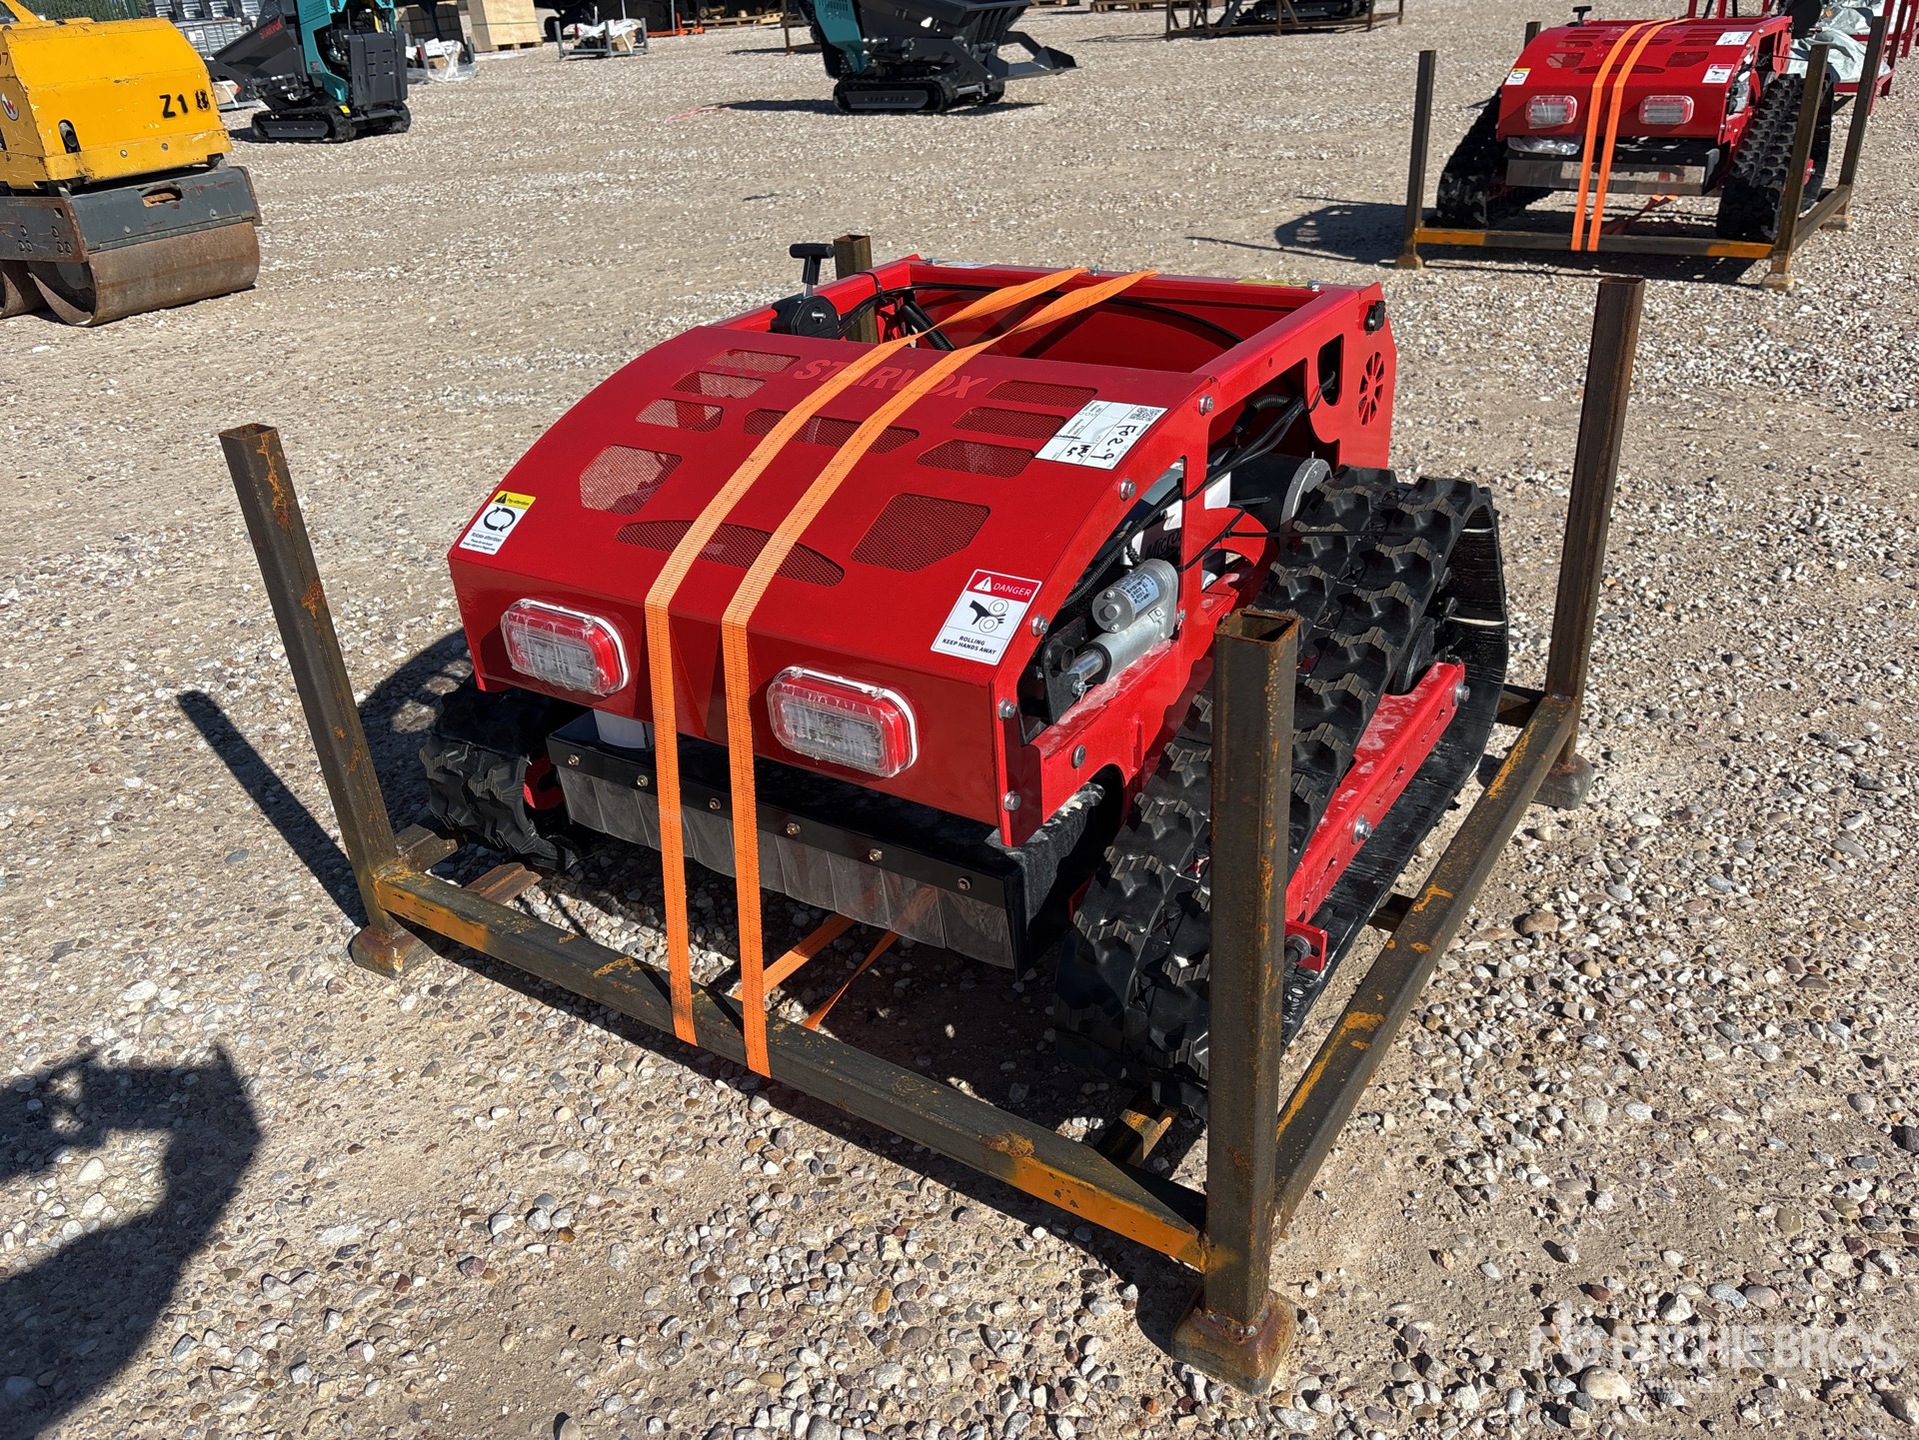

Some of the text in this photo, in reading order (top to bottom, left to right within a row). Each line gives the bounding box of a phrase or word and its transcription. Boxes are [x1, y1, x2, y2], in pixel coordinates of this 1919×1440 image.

[0, 52, 9, 66] 7
[793, 359, 988, 399] STRVOX
[993, 583, 1032, 597] DANGER
[959, 636, 985, 645] ROLLING
[958, 642, 978, 650] HANDS
[979, 646, 996, 654] AWAY
